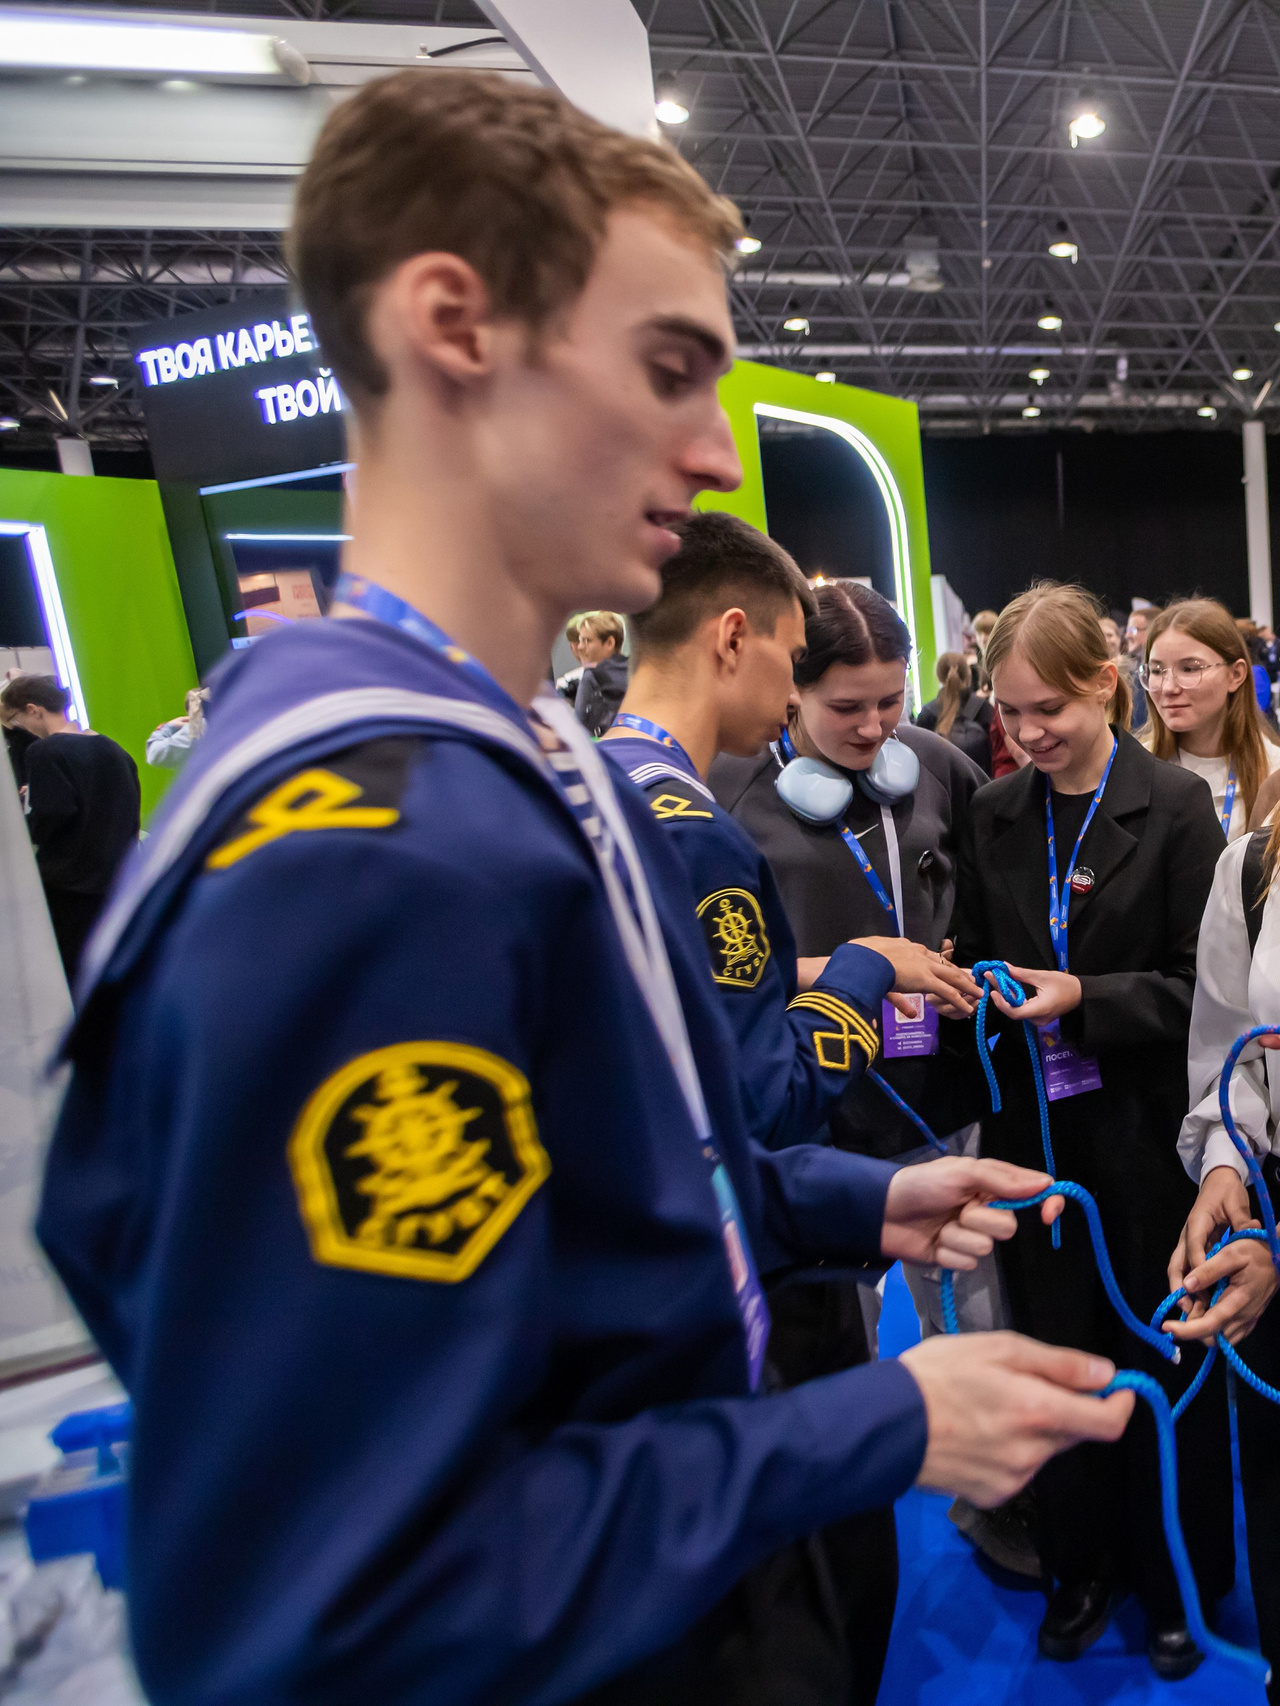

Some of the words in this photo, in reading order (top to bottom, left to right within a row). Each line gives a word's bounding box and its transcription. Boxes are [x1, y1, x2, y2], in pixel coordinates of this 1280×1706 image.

[138, 337, 216, 386] ТВОЯ
[215, 314, 319, 370] КАРЬЕ
[257, 367, 342, 424] ТВОЙ
